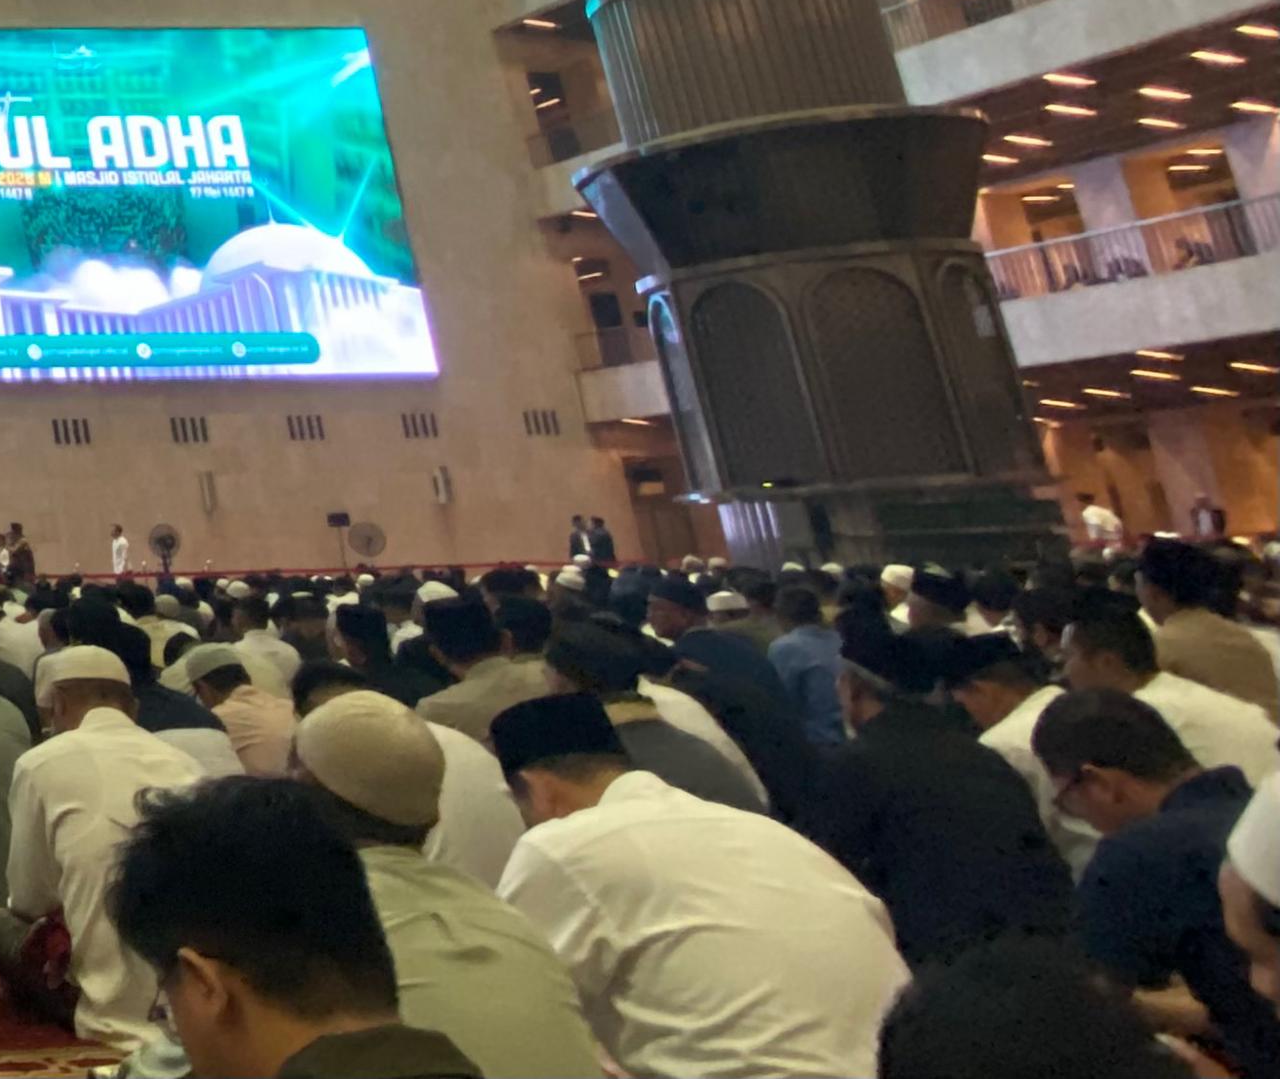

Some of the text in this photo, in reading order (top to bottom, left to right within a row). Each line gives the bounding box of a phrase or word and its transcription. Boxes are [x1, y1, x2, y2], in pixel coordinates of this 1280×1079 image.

[87, 115, 250, 169] ADHA
[64, 170, 119, 185] MASJID
[122, 170, 185, 185] ISTIQLAL
